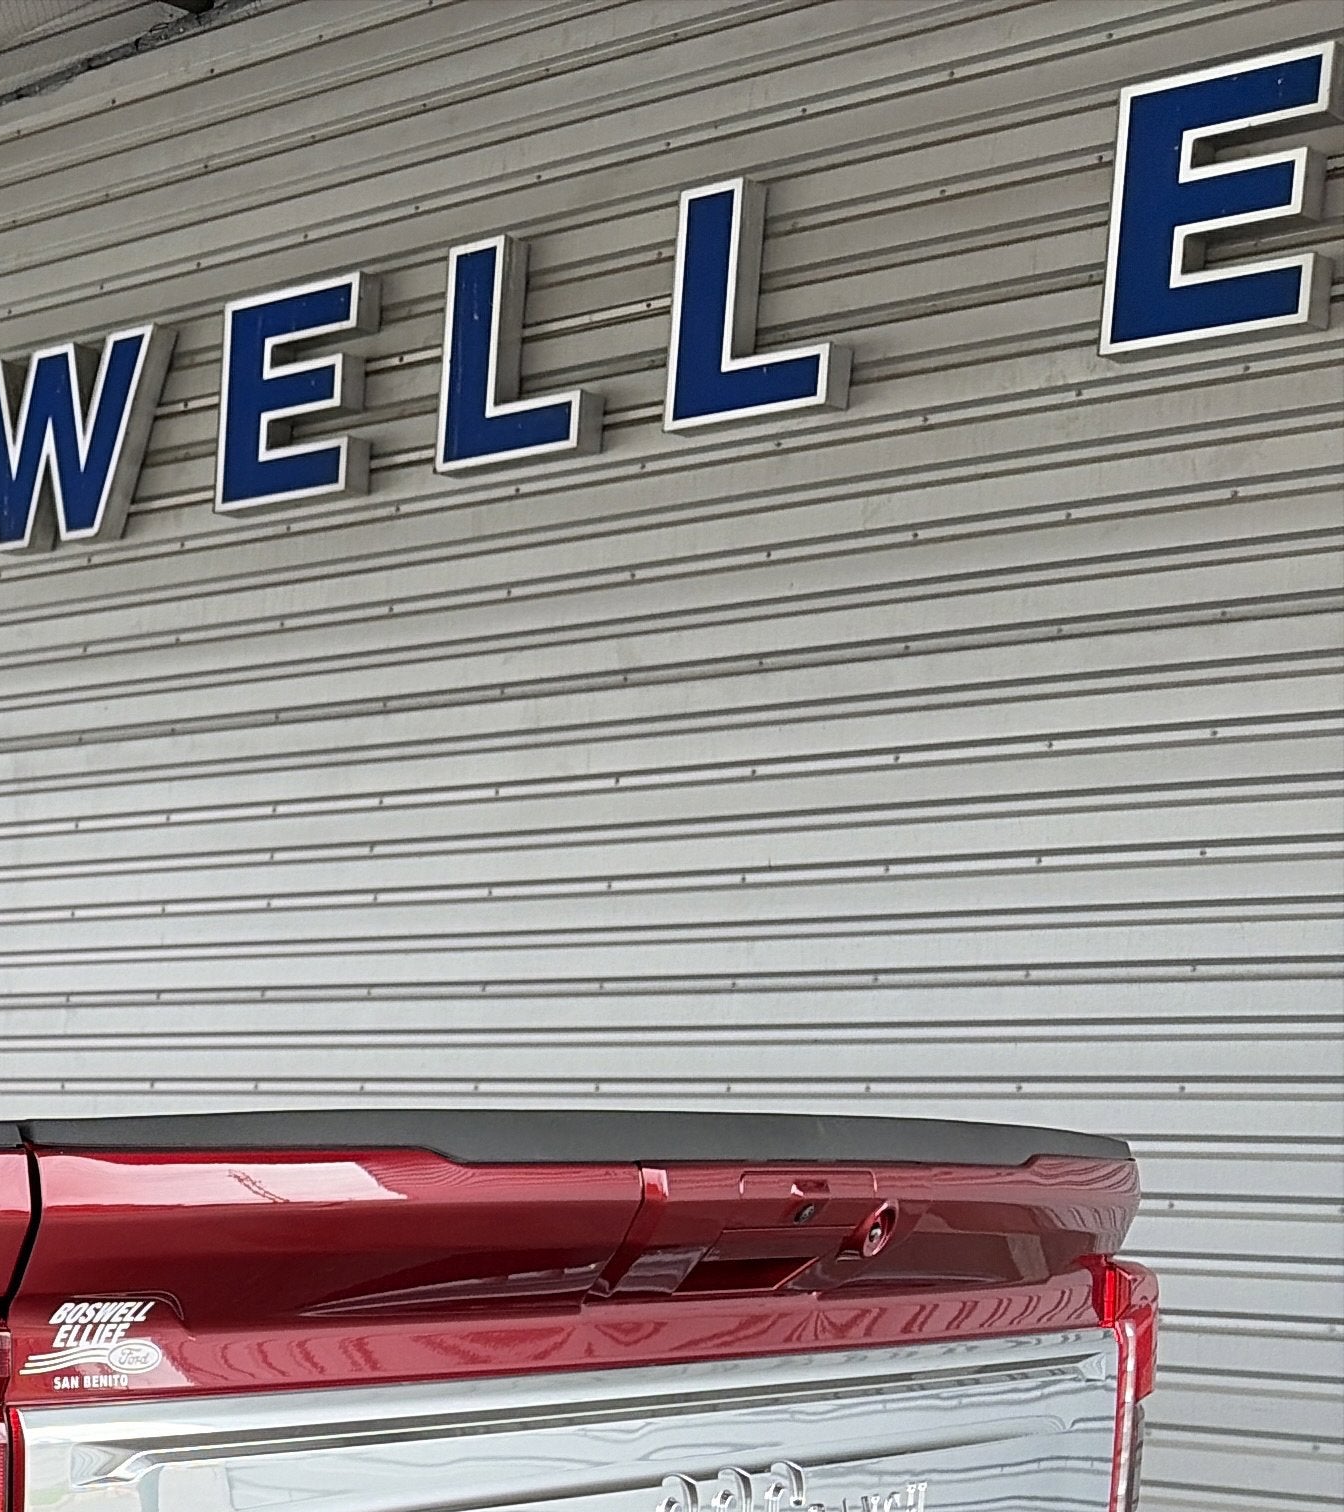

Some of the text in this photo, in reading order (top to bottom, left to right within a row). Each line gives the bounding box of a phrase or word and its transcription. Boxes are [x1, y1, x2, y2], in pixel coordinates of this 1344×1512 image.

[49, 1300, 155, 1324] BOSWELL
[53, 1322, 130, 1348] ELLIFF
[118, 1347, 150, 1366] Ford
[53, 1374, 128, 1390] SAN BENITO
